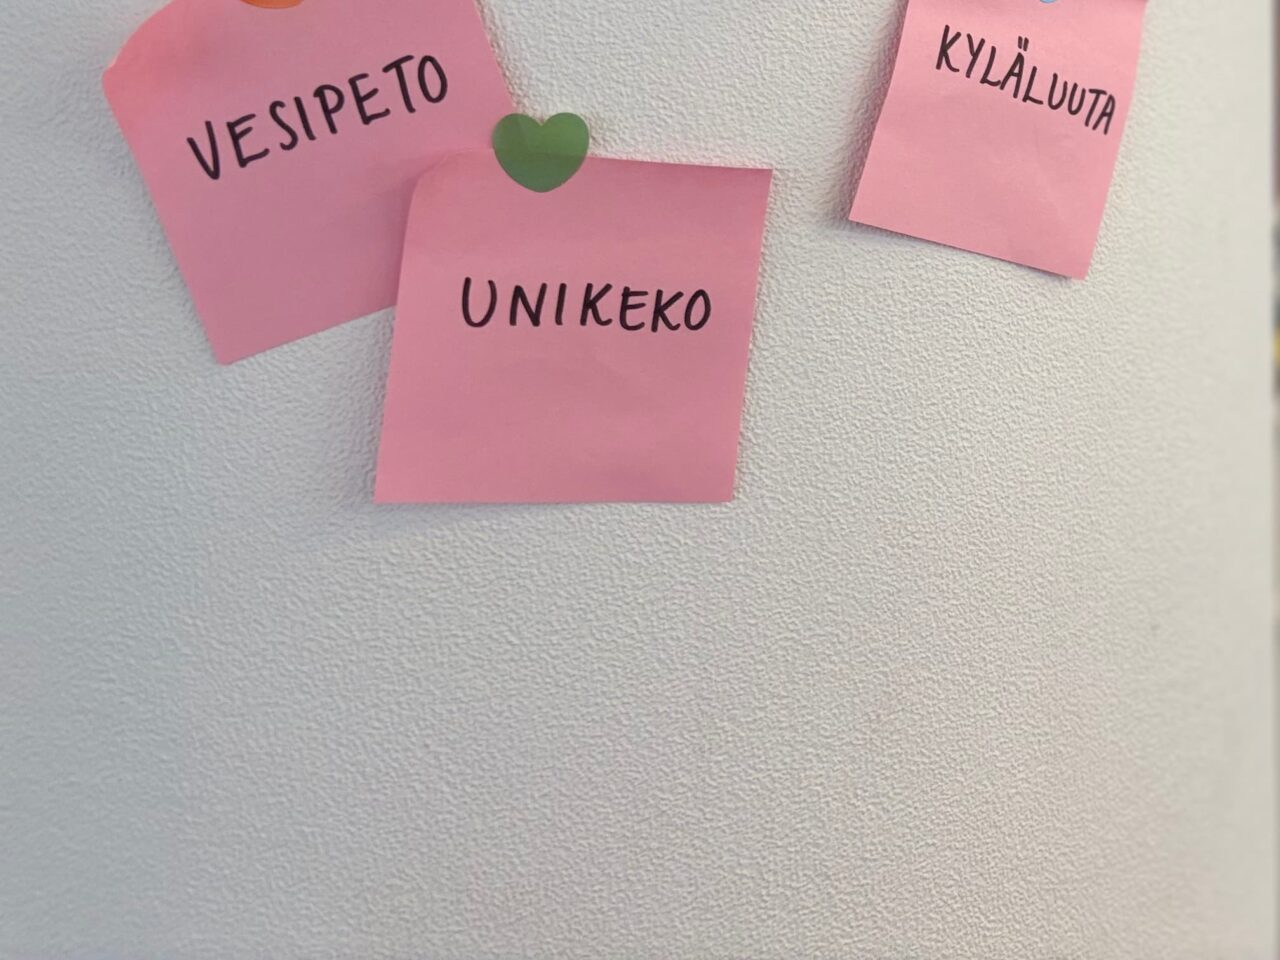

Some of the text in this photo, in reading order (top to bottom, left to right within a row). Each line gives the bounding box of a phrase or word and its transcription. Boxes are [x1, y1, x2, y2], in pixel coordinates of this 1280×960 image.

[186, 54, 448, 181] VESIPETO
[935, 24, 1116, 135] KYLÄLUUTA
[461, 276, 712, 333] UNIKEKO
